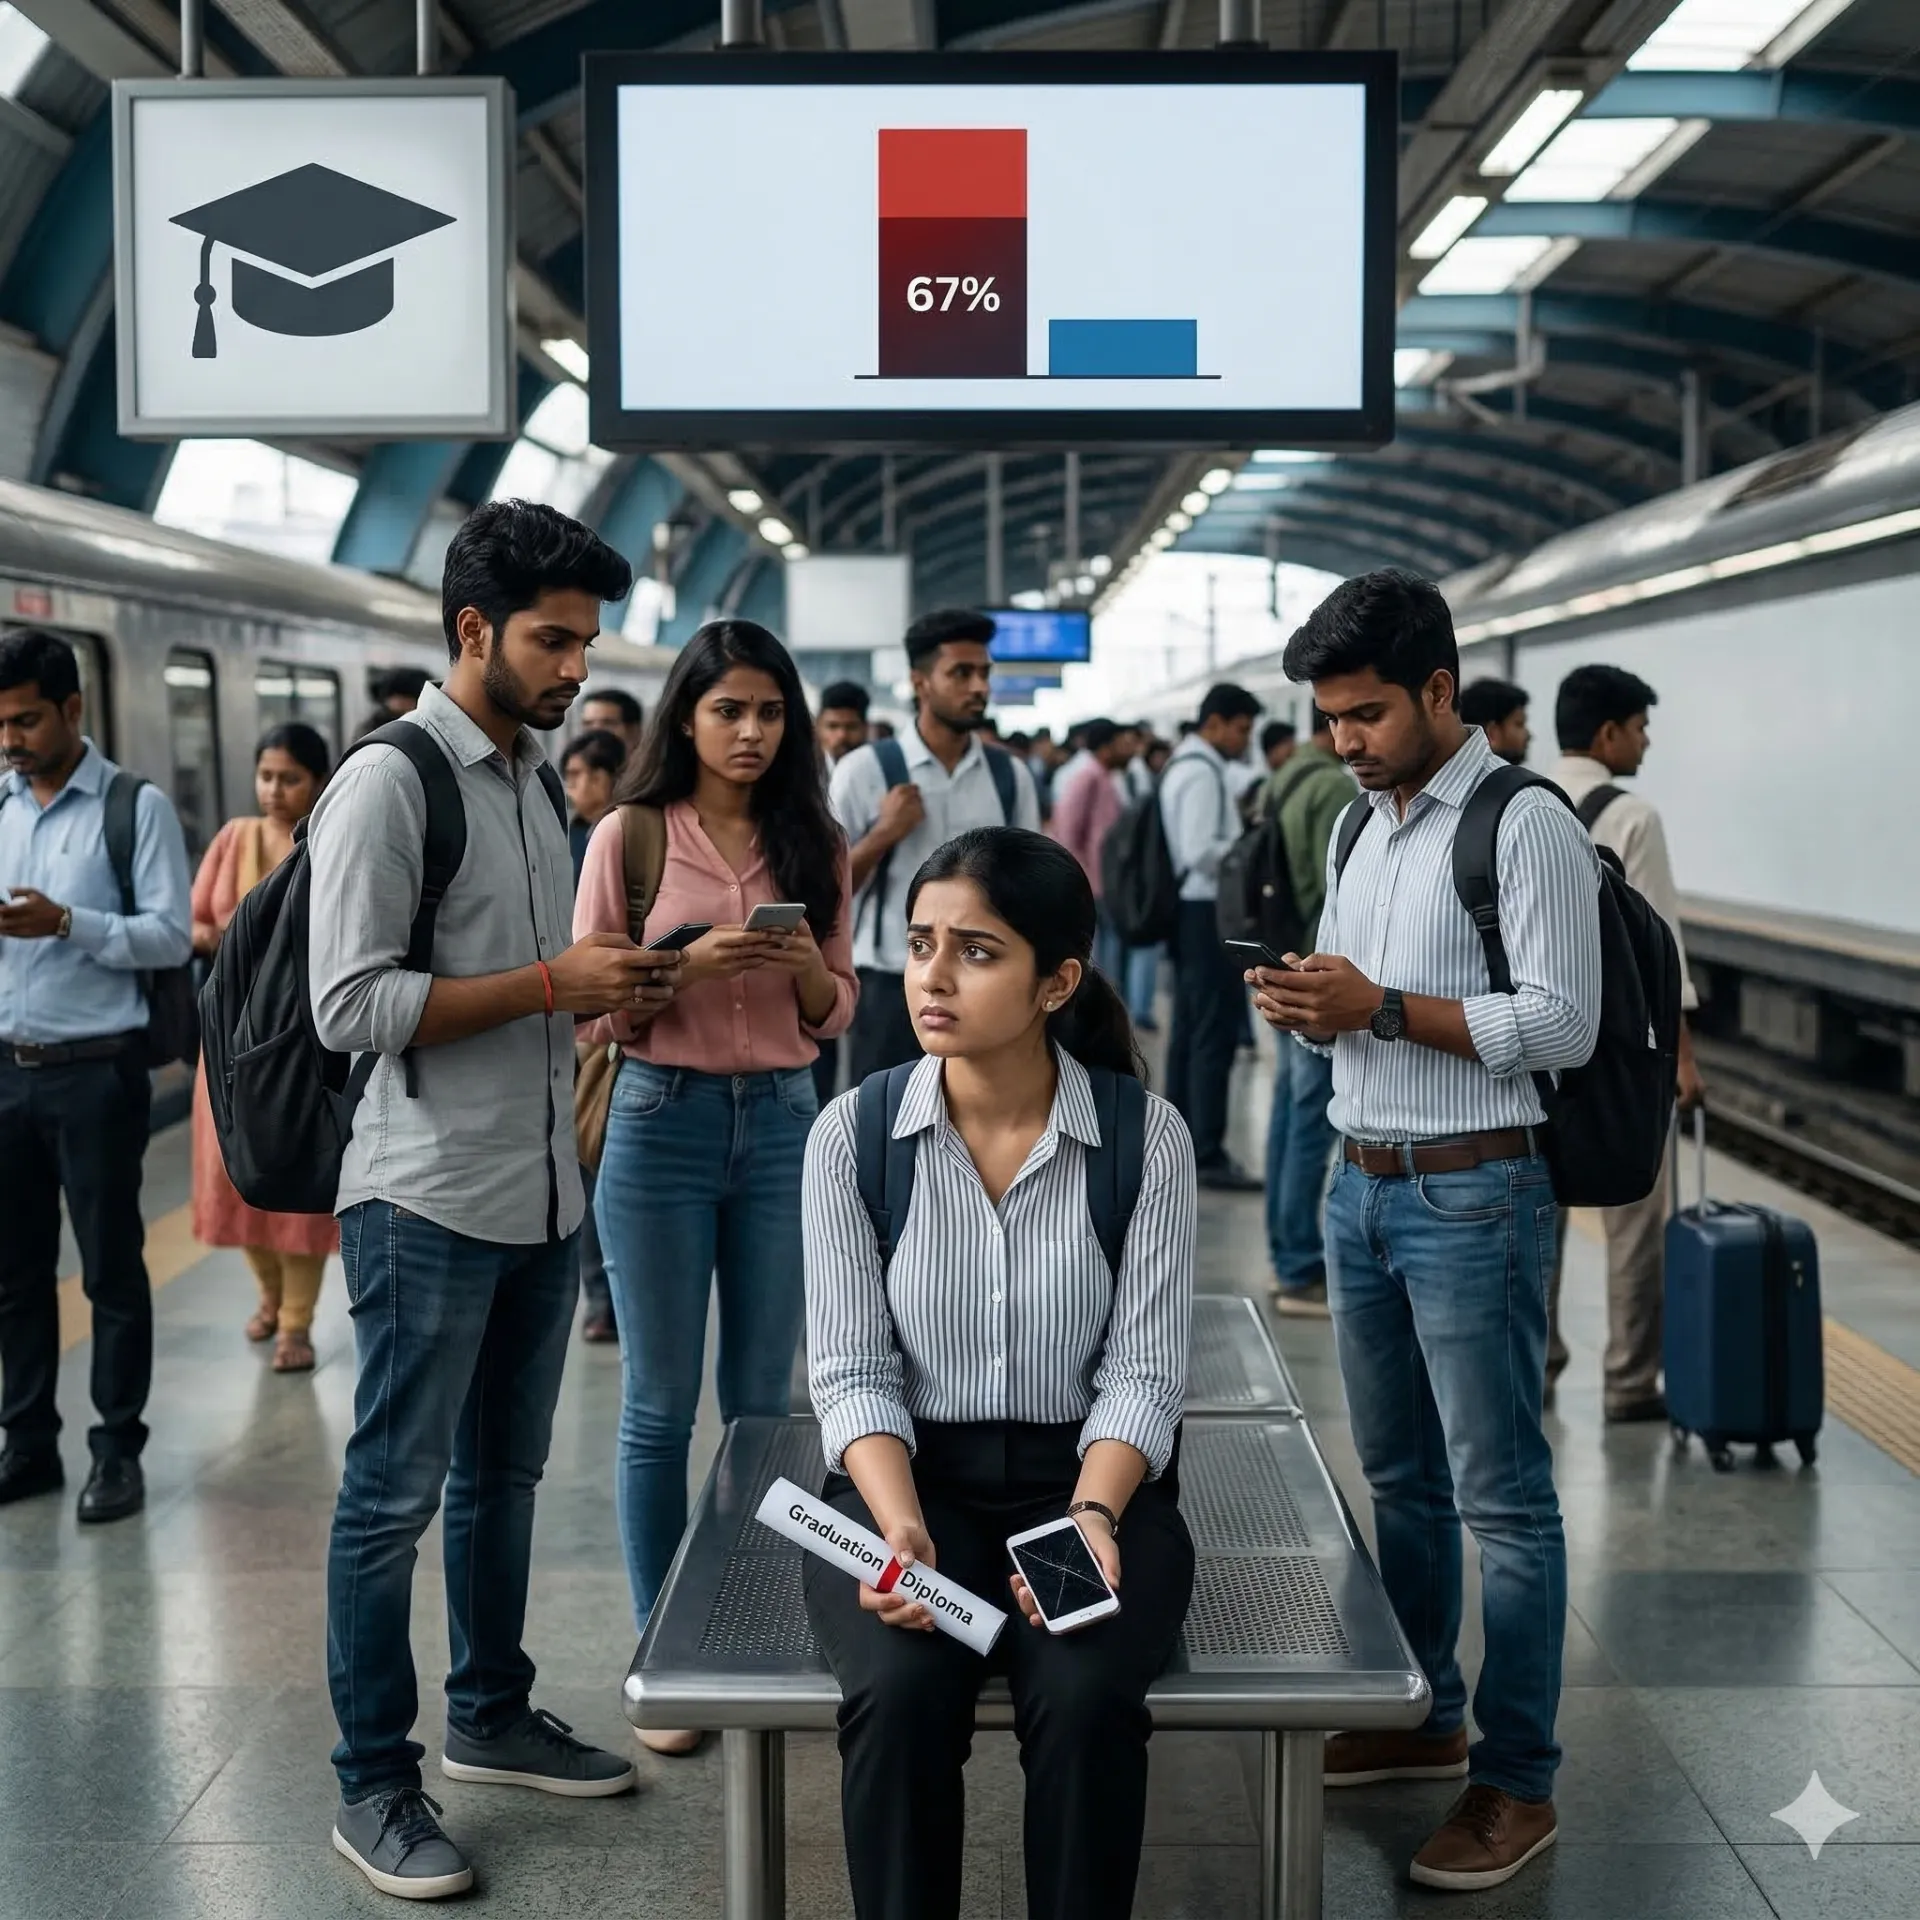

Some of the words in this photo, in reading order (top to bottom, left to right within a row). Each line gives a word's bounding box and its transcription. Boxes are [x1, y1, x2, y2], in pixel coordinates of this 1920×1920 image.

[906, 275, 1001, 312] 67%
[788, 1503, 885, 1572] Graduation
[899, 1570, 974, 1627] Diploma
